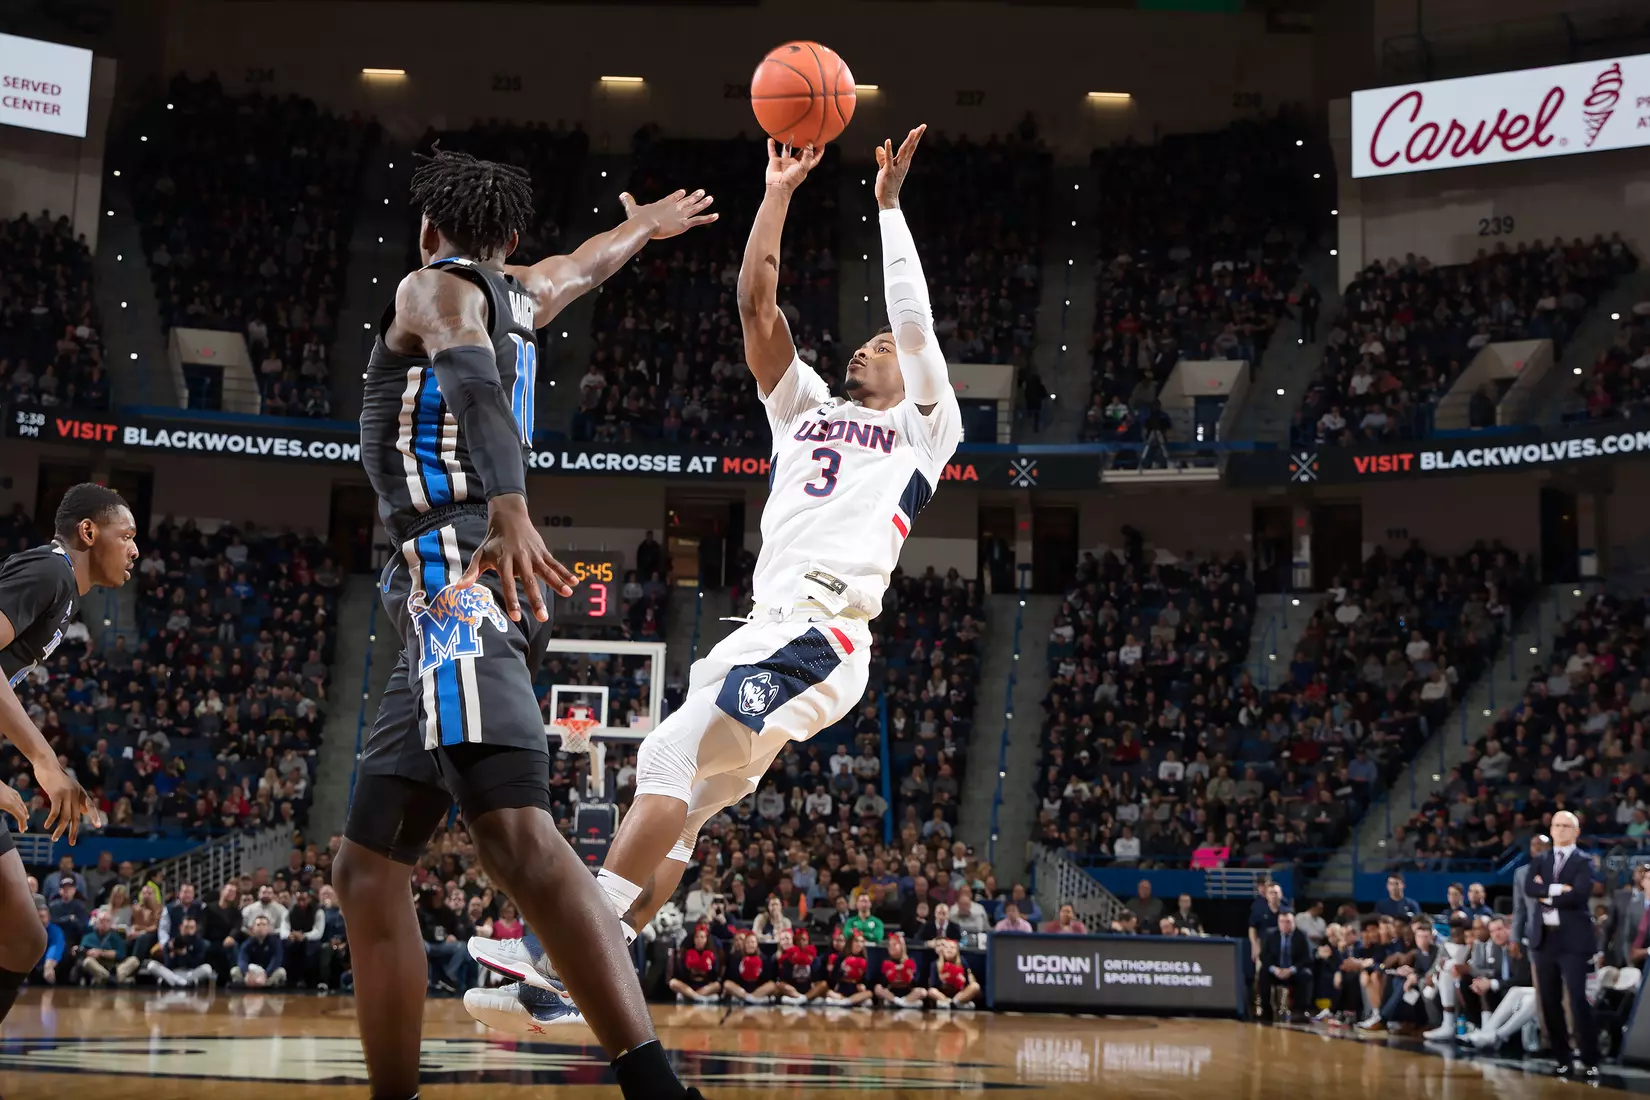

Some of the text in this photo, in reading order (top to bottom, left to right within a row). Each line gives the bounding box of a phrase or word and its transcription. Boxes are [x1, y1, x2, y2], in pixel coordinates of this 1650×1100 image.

[3, 75, 62, 96] SERVED
[2, 95, 61, 116] CENTER
[955, 90, 985, 106] 237
[1369, 86, 1566, 168] Carvel
[1478, 215, 1515, 237] 239
[16, 411, 46, 426] 3:38
[19, 425, 39, 438] PM
[56, 418, 361, 462] VISIT BLACKWOLVES.COM
[793, 419, 896, 454] UCONN
[1353, 430, 1650, 474] VISIT BLACKWOLVES.COM
[561, 452, 681, 473] LACROSSE
[686, 456, 718, 474] AT
[803, 447, 842, 498] 3
[1019, 479, 1029, 488] W
[544, 515, 572, 528] 109
[574, 562, 613, 582] 5:45
[588, 583, 607, 617] 3
[411, 609, 484, 678] M
[1017, 955, 1091, 974] UCONN
[1103, 959, 1202, 973] ORTHOPEDICS &
[1025, 973, 1083, 985] HEALTH
[1103, 972, 1213, 987] SPORTS MEDICINE
